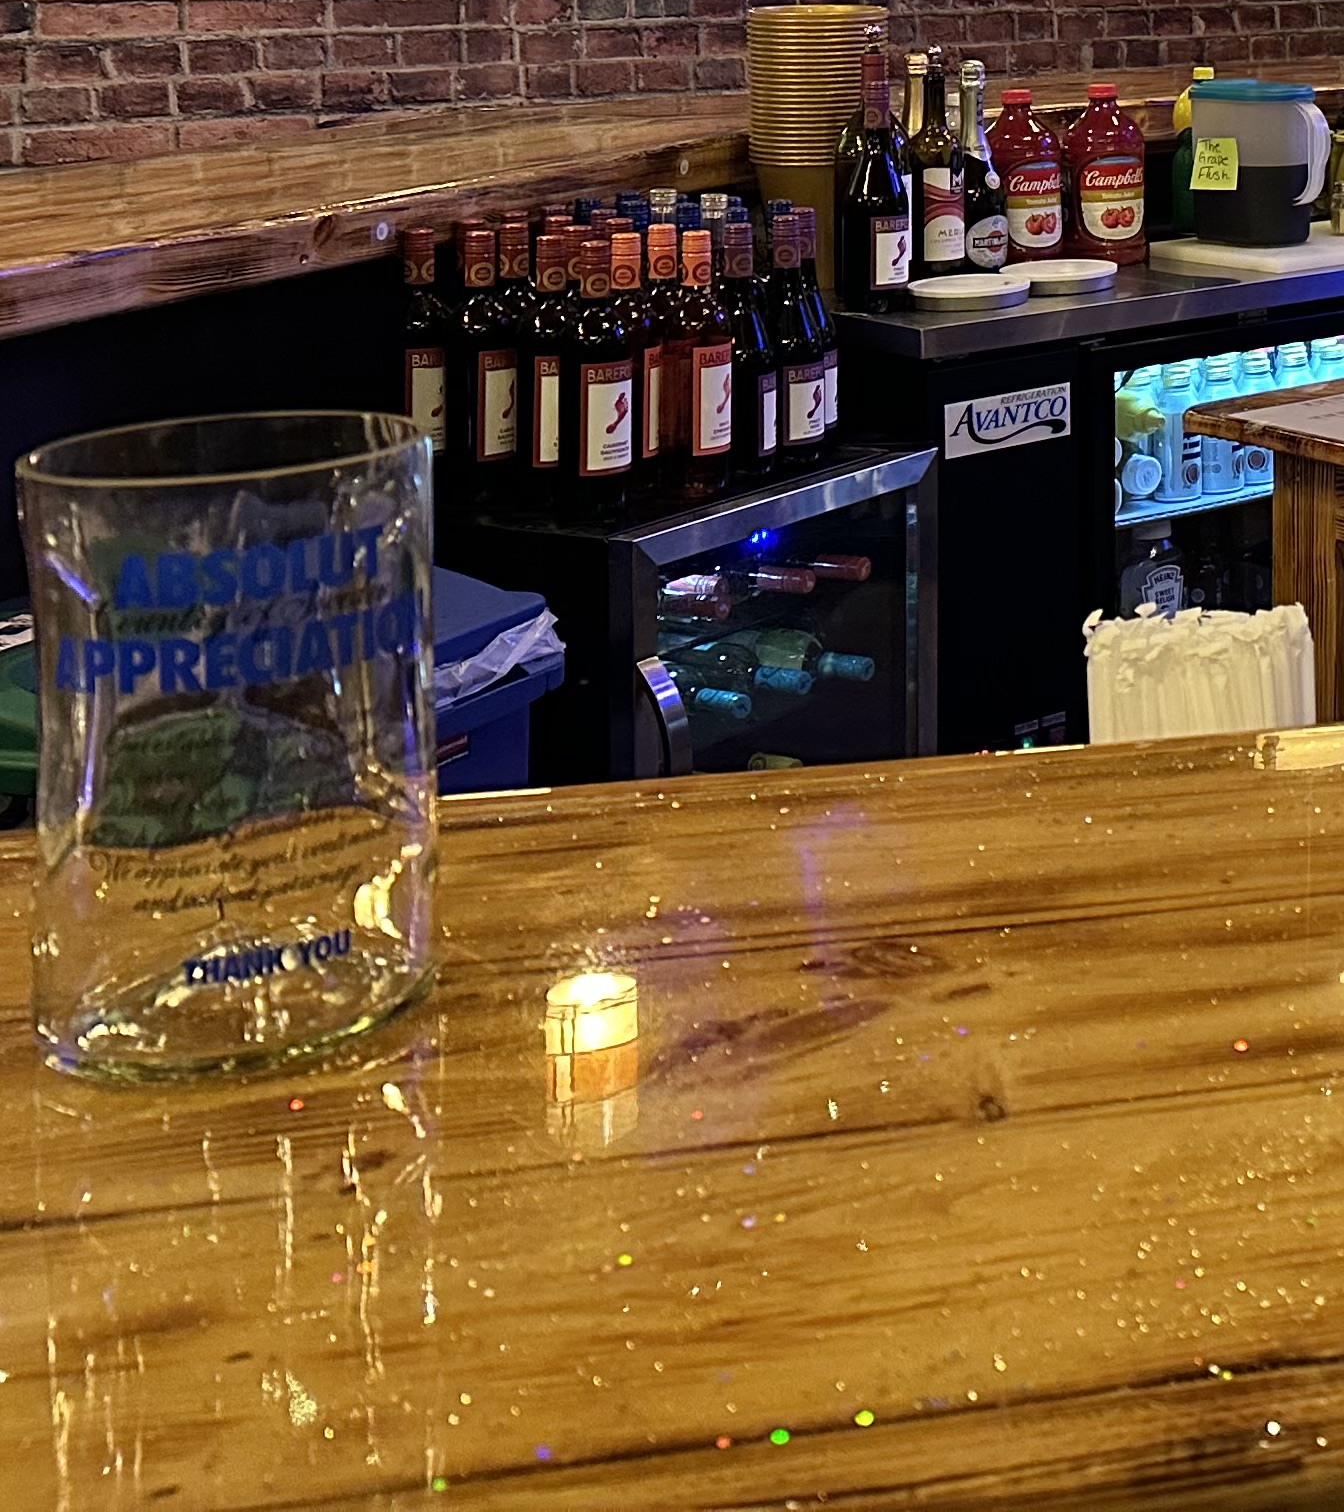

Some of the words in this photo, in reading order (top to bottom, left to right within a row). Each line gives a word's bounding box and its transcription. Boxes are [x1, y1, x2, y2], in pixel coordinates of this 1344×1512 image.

[1200, 139, 1221, 153] The
[1198, 152, 1229, 167] Grape
[1198, 166, 1231, 180] Flush
[1001, 386, 1067, 405] REFRIGERATION
[949, 398, 1067, 441] AVANTCO
[114, 525, 382, 610] ABSOLUT
[1154, 572, 1175, 585] HEINZ
[1155, 587, 1175, 598] SWEET
[181, 944, 287, 985] THANK
[296, 928, 352, 968] YOU
